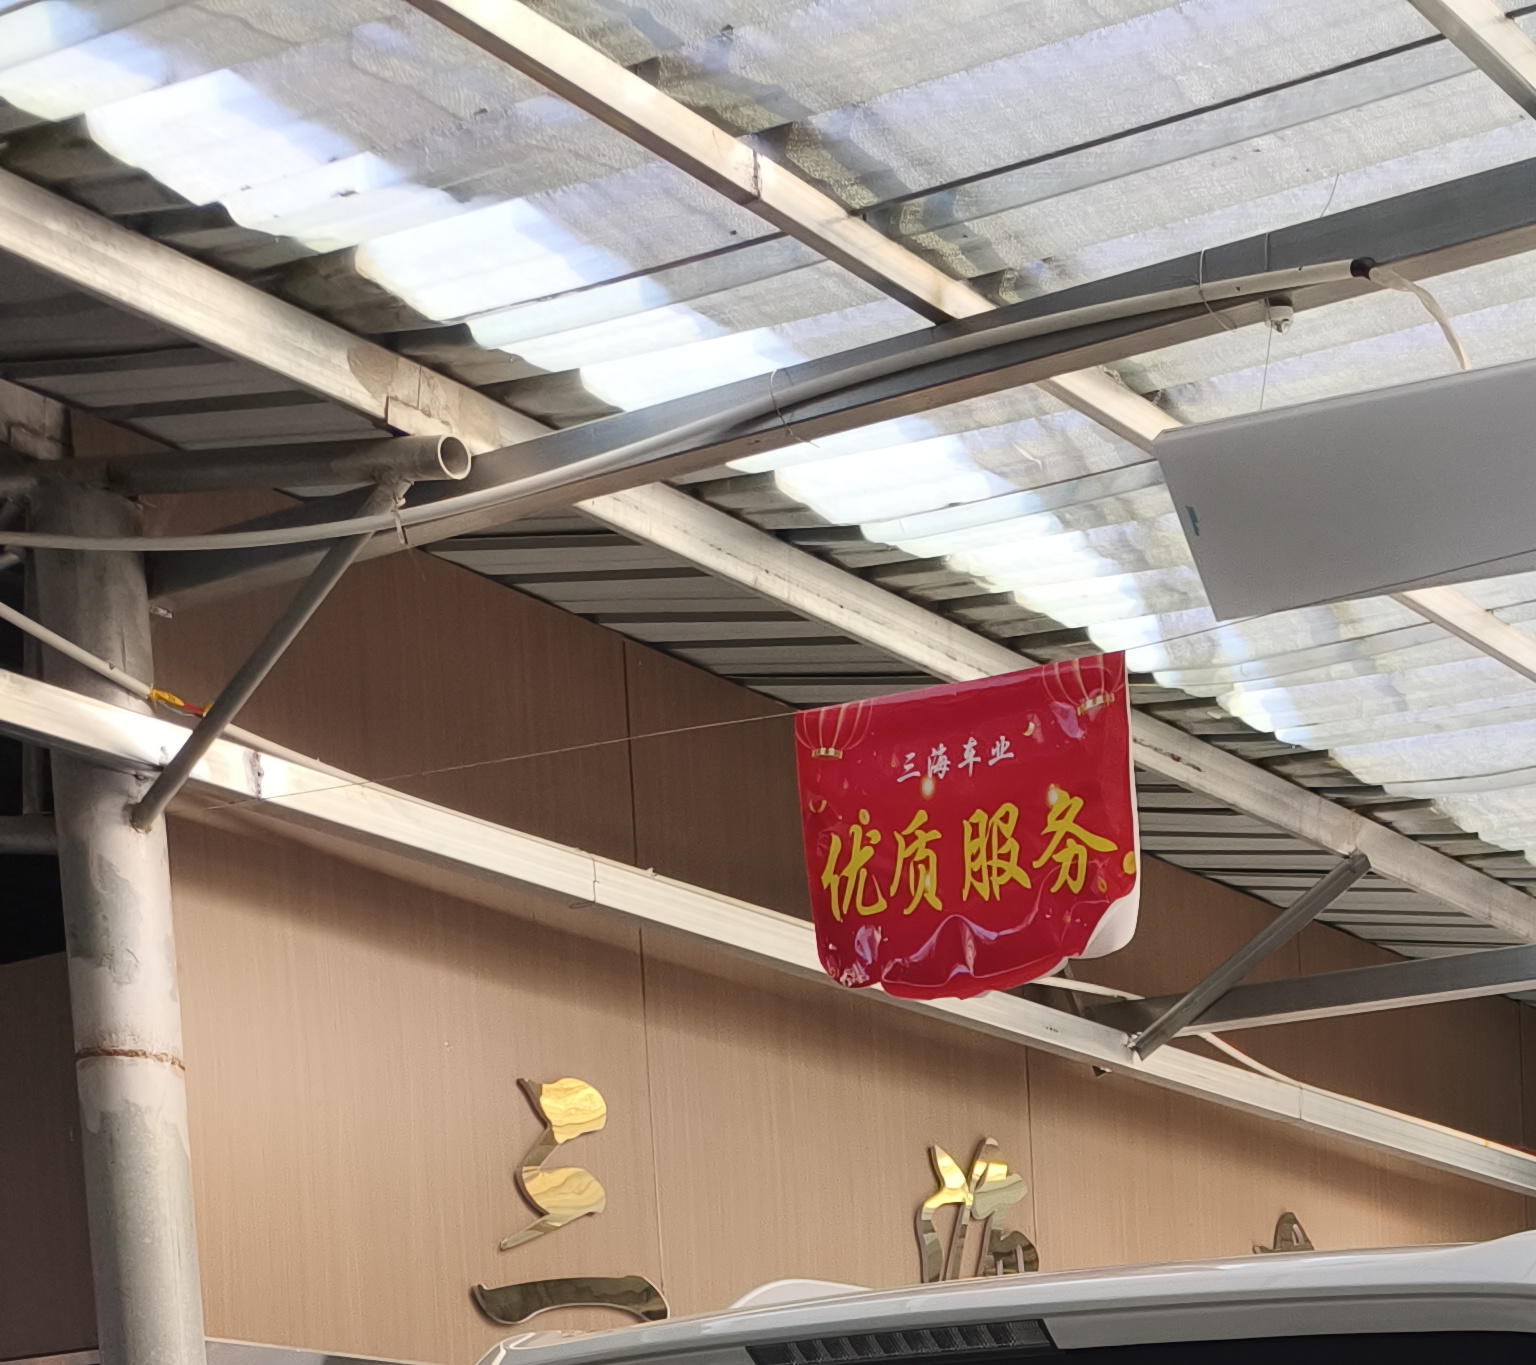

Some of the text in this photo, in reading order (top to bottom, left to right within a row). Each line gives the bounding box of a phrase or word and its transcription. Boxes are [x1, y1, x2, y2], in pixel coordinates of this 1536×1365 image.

[896, 735, 1015, 784] 三海车业
[820, 786, 1119, 922] 优质服务
